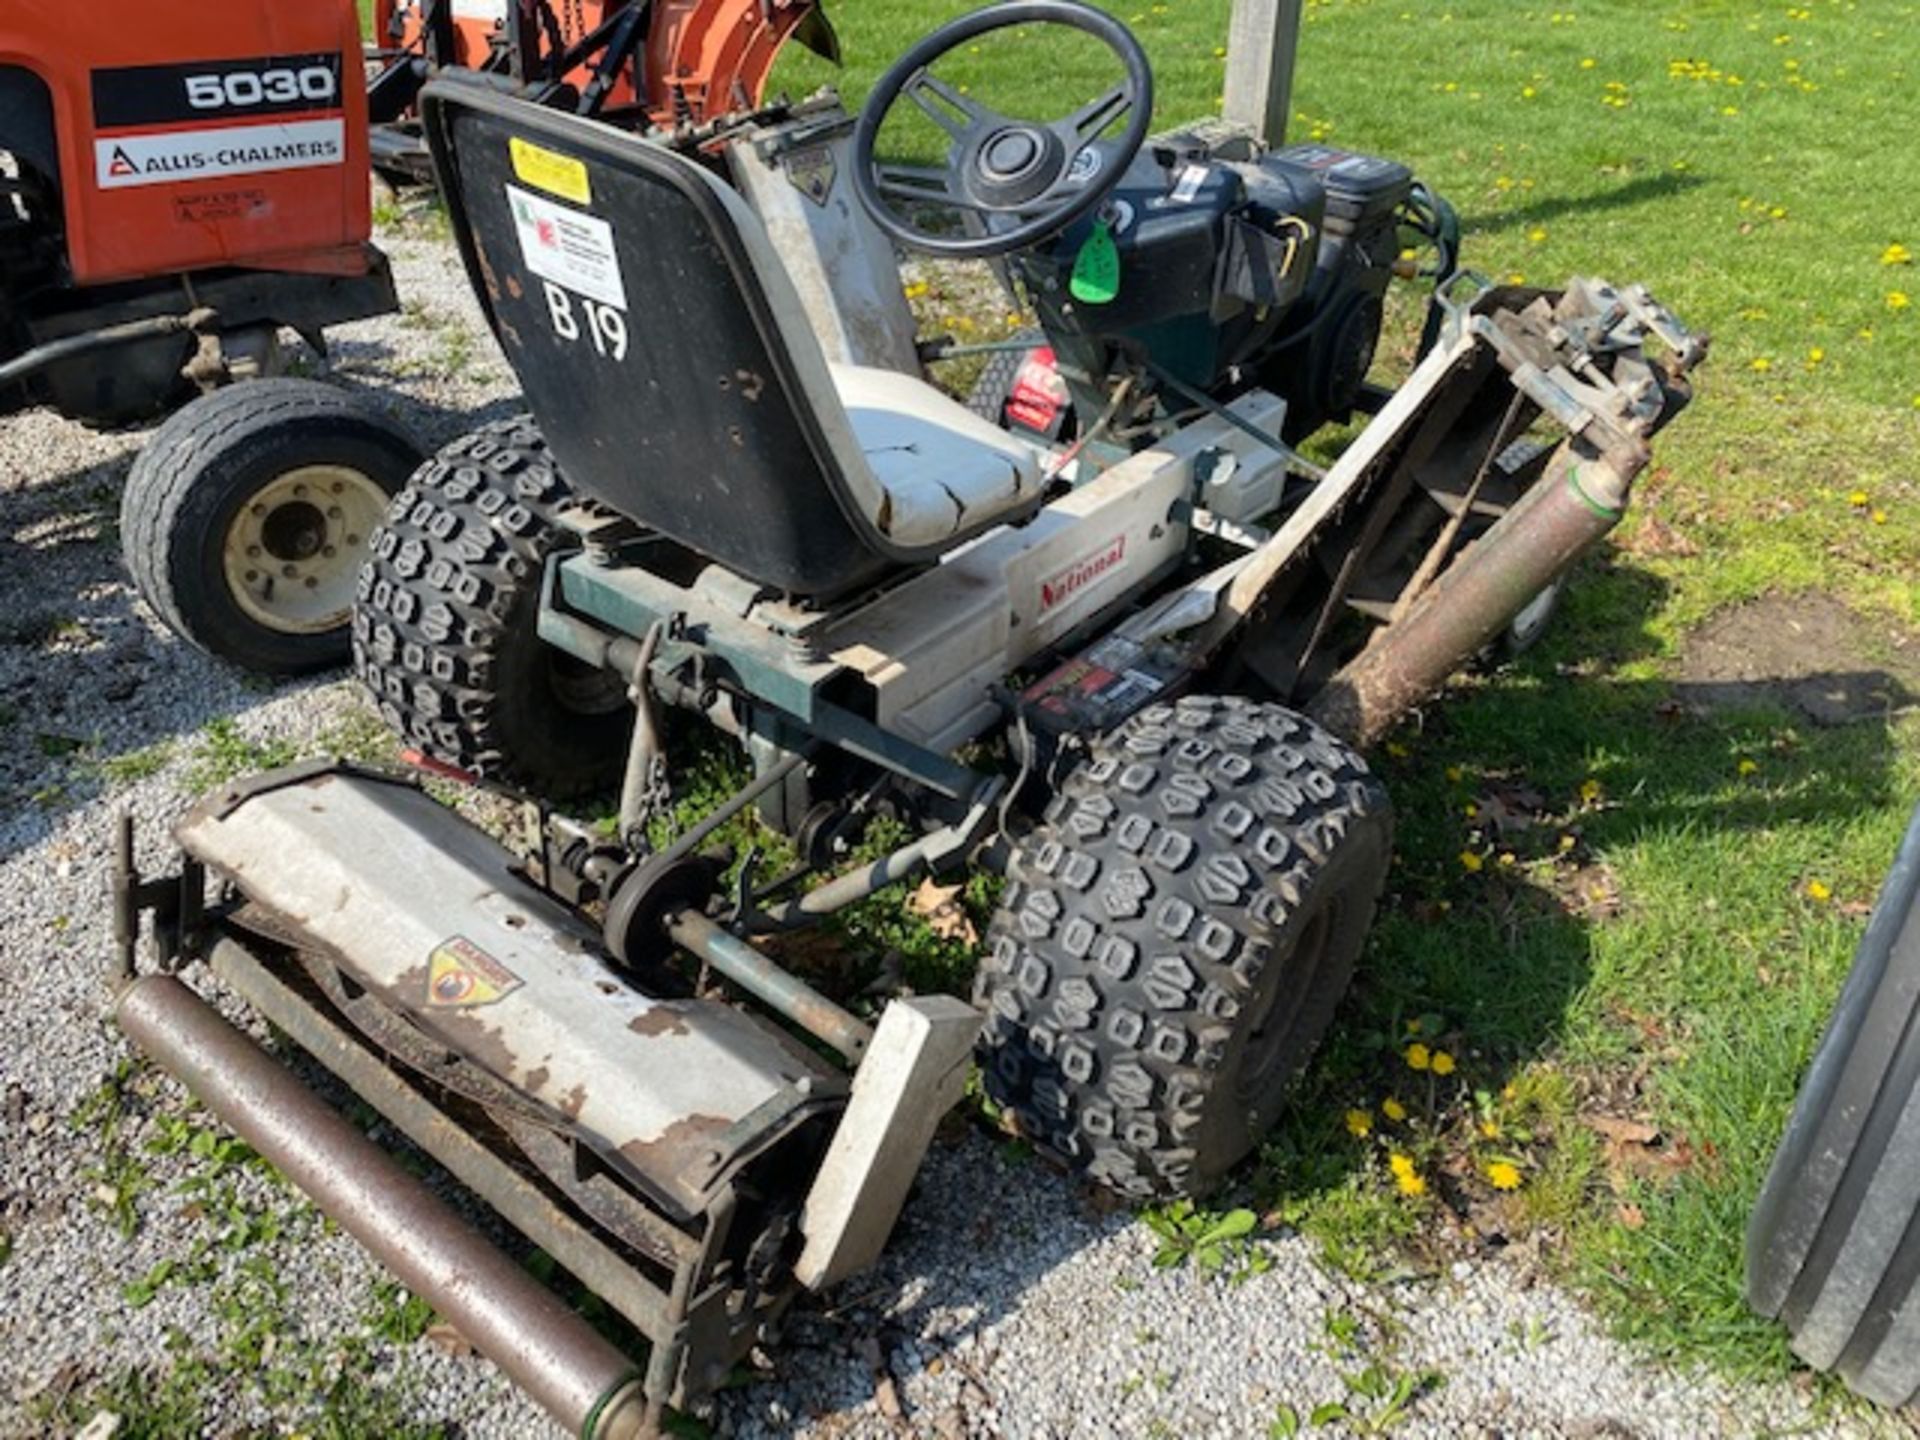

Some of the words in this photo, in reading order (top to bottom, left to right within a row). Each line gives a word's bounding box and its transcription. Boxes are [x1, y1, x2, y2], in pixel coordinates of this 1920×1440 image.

[185, 65, 337, 109] 5030
[145, 140, 338, 172] ALLIS-CHALMERS
[543, 281, 579, 340] B
[581, 299, 628, 362] 19
[1041, 533, 1127, 613] National
